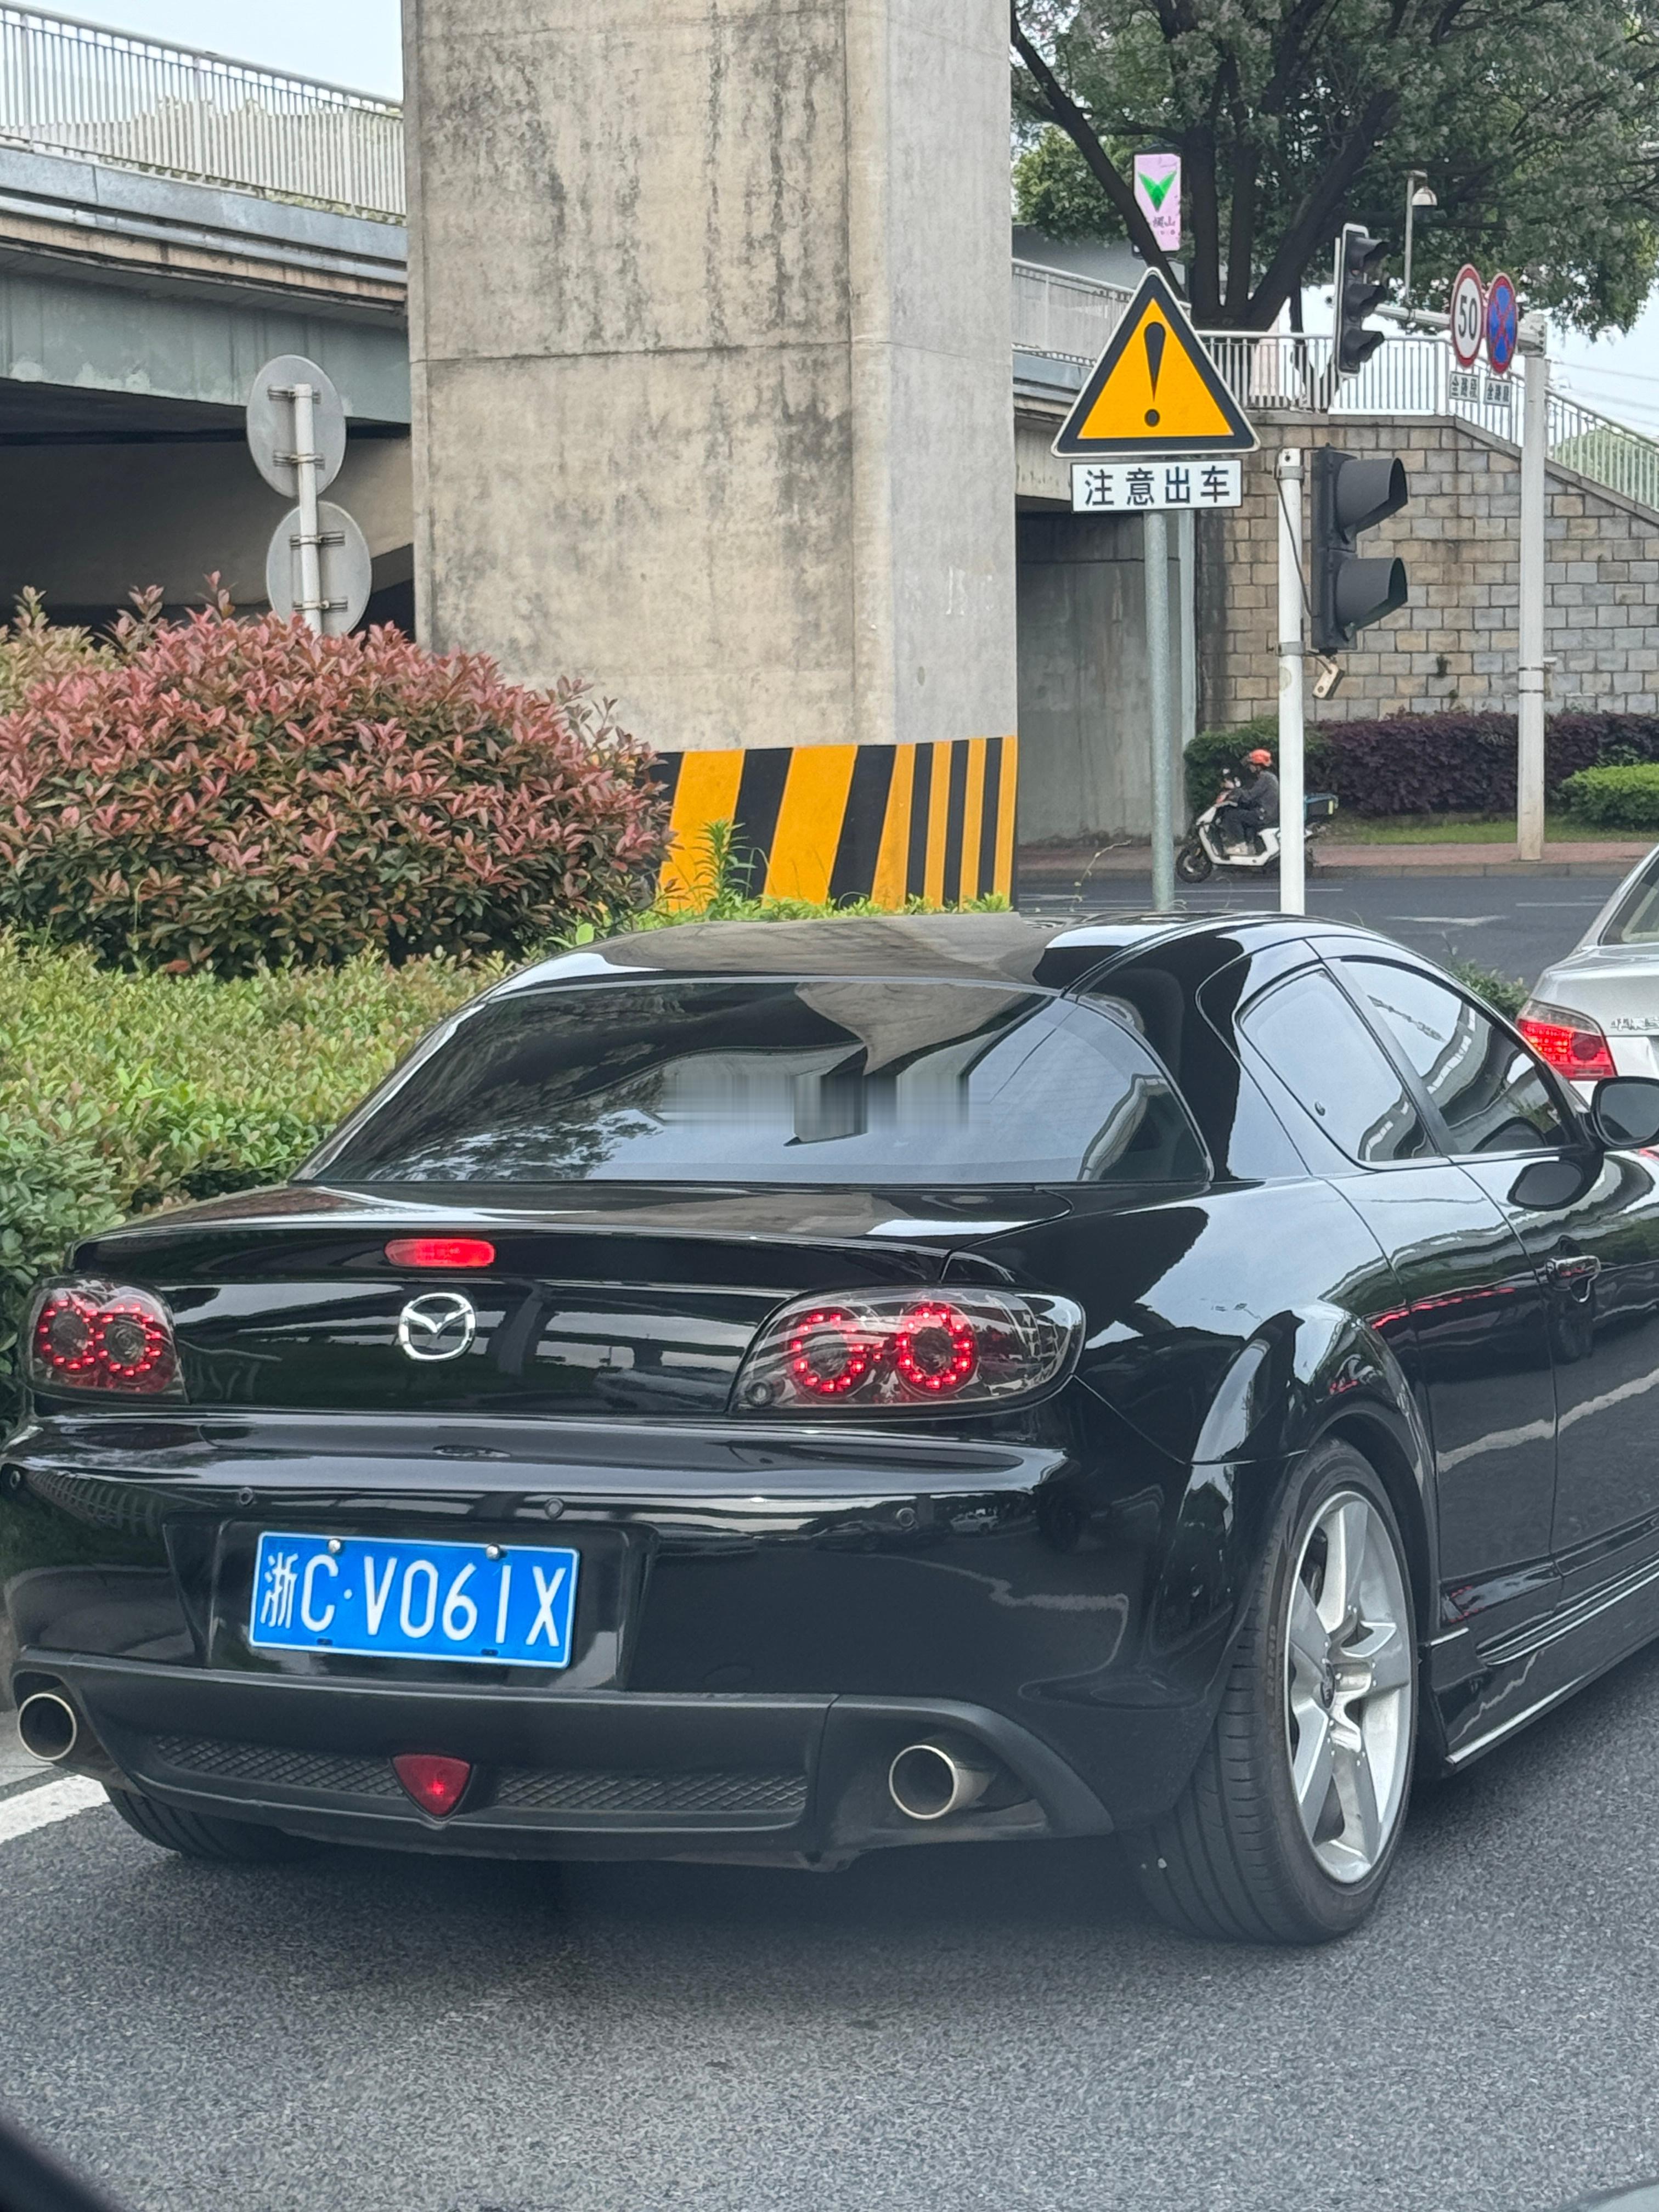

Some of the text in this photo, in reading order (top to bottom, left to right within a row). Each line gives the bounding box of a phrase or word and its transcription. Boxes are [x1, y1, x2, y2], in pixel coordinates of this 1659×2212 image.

[1458, 294, 1478, 341] 50
[1085, 465, 1230, 506] 注意出车
[260, 1552, 567, 1646] 浙C·V061X
